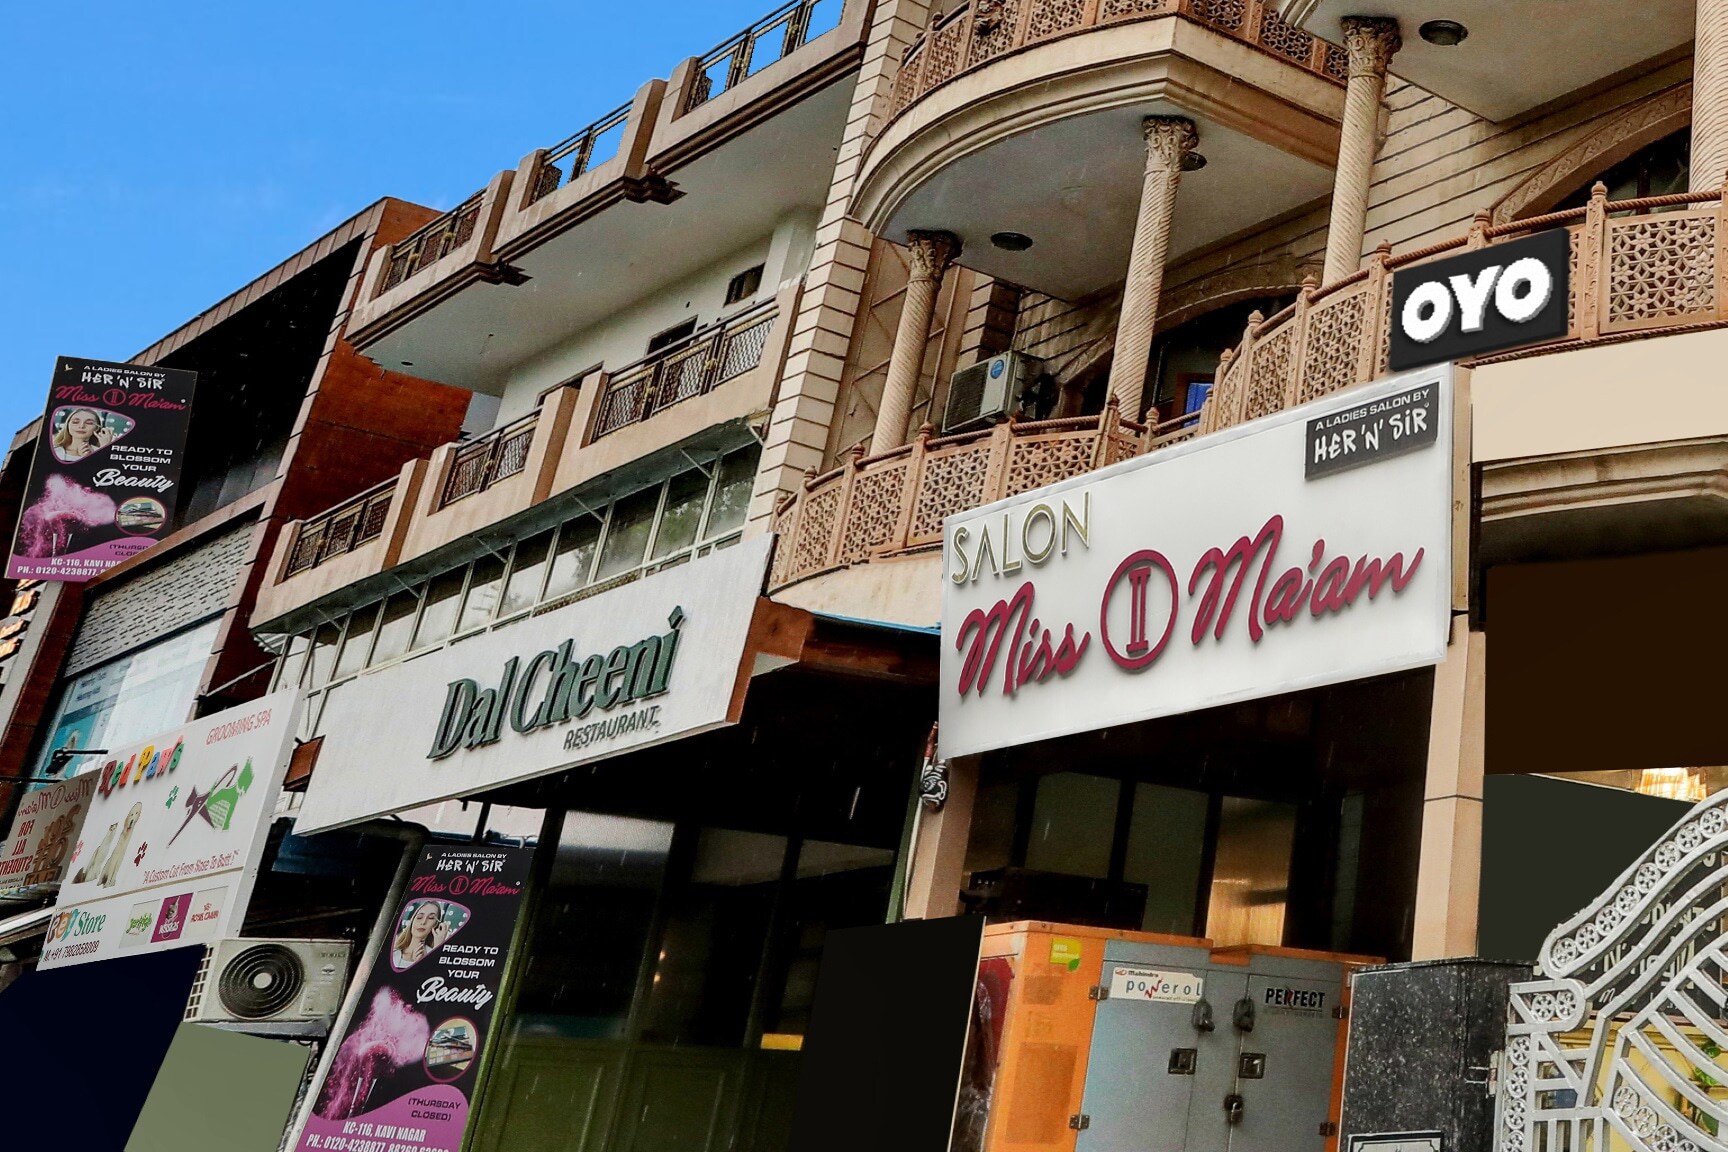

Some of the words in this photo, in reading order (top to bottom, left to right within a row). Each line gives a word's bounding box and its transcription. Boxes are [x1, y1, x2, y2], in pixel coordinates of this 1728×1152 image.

[1402, 257, 1553, 344] OYO
[81, 372, 114, 386] HER
[92, 366, 122, 374] LADIES
[124, 369, 152, 378] SALON
[55, 385, 100, 403] Miss
[1315, 421, 1325, 432] A
[1326, 408, 1368, 429] LADIES
[1370, 394, 1412, 415] SALON
[1412, 388, 1430, 403] BY
[111, 445, 154, 454] READY
[156, 448, 173, 456] TO
[1314, 429, 1357, 464] HER
[109, 453, 172, 465] BLOSSOM
[122, 463, 157, 472] YOUR
[92, 468, 175, 493] Beauty
[951, 490, 1092, 585] SALON
[83, 559, 104, 567] KAVI
[956, 581, 1092, 697] Miss
[1188, 514, 1425, 645] Ma'am
[206, 714, 255, 745] GROOMING
[254, 708, 272, 729] SPA
[563, 705, 661, 750] RESTAURANT
[436, 859, 462, 872] HER
[410, 874, 448, 894] Miss
[74, 911, 106, 937] Store
[442, 944, 482, 954] READY
[483, 947, 499, 955] TO
[438, 956, 496, 967] BLOSSOM
[448, 969, 480, 979] YOUR
[416, 976, 494, 1011] Beauty
[1265, 988, 1326, 1008] PERFECT
[408, 1097, 462, 1110] (THURSDAY
[411, 1110, 452, 1122] CLOSED)
[342, 1121, 373, 1138] KC-116,
[374, 1124, 398, 1140] KAVI
[398, 1126, 427, 1143] NAGAR
